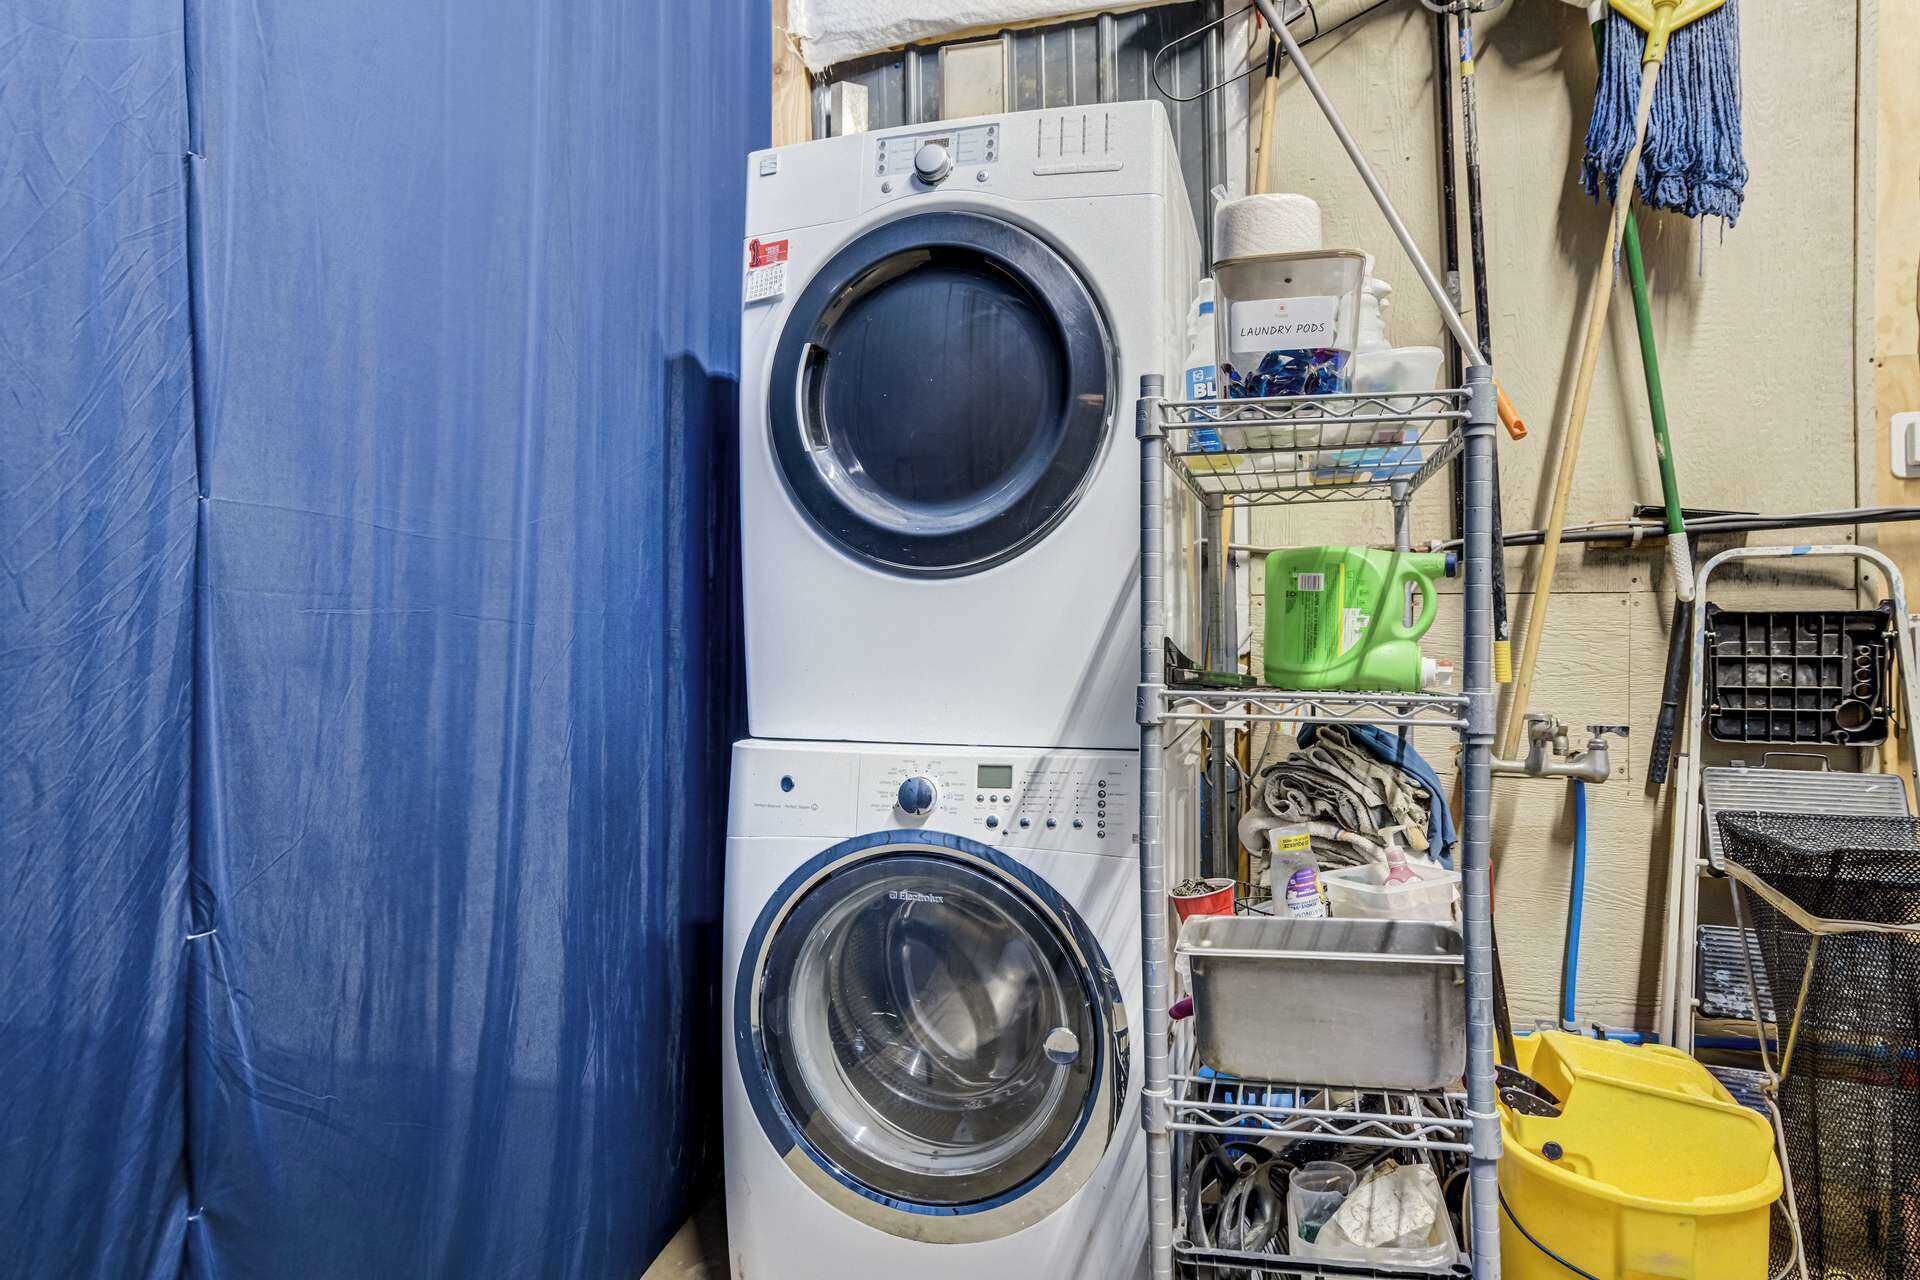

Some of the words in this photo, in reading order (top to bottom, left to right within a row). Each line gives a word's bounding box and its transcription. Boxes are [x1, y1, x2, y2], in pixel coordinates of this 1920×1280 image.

[1240, 325, 1292, 337] LAUNDRY
[1296, 322, 1325, 333] PODS
[900, 889, 944, 904] Electrolux
